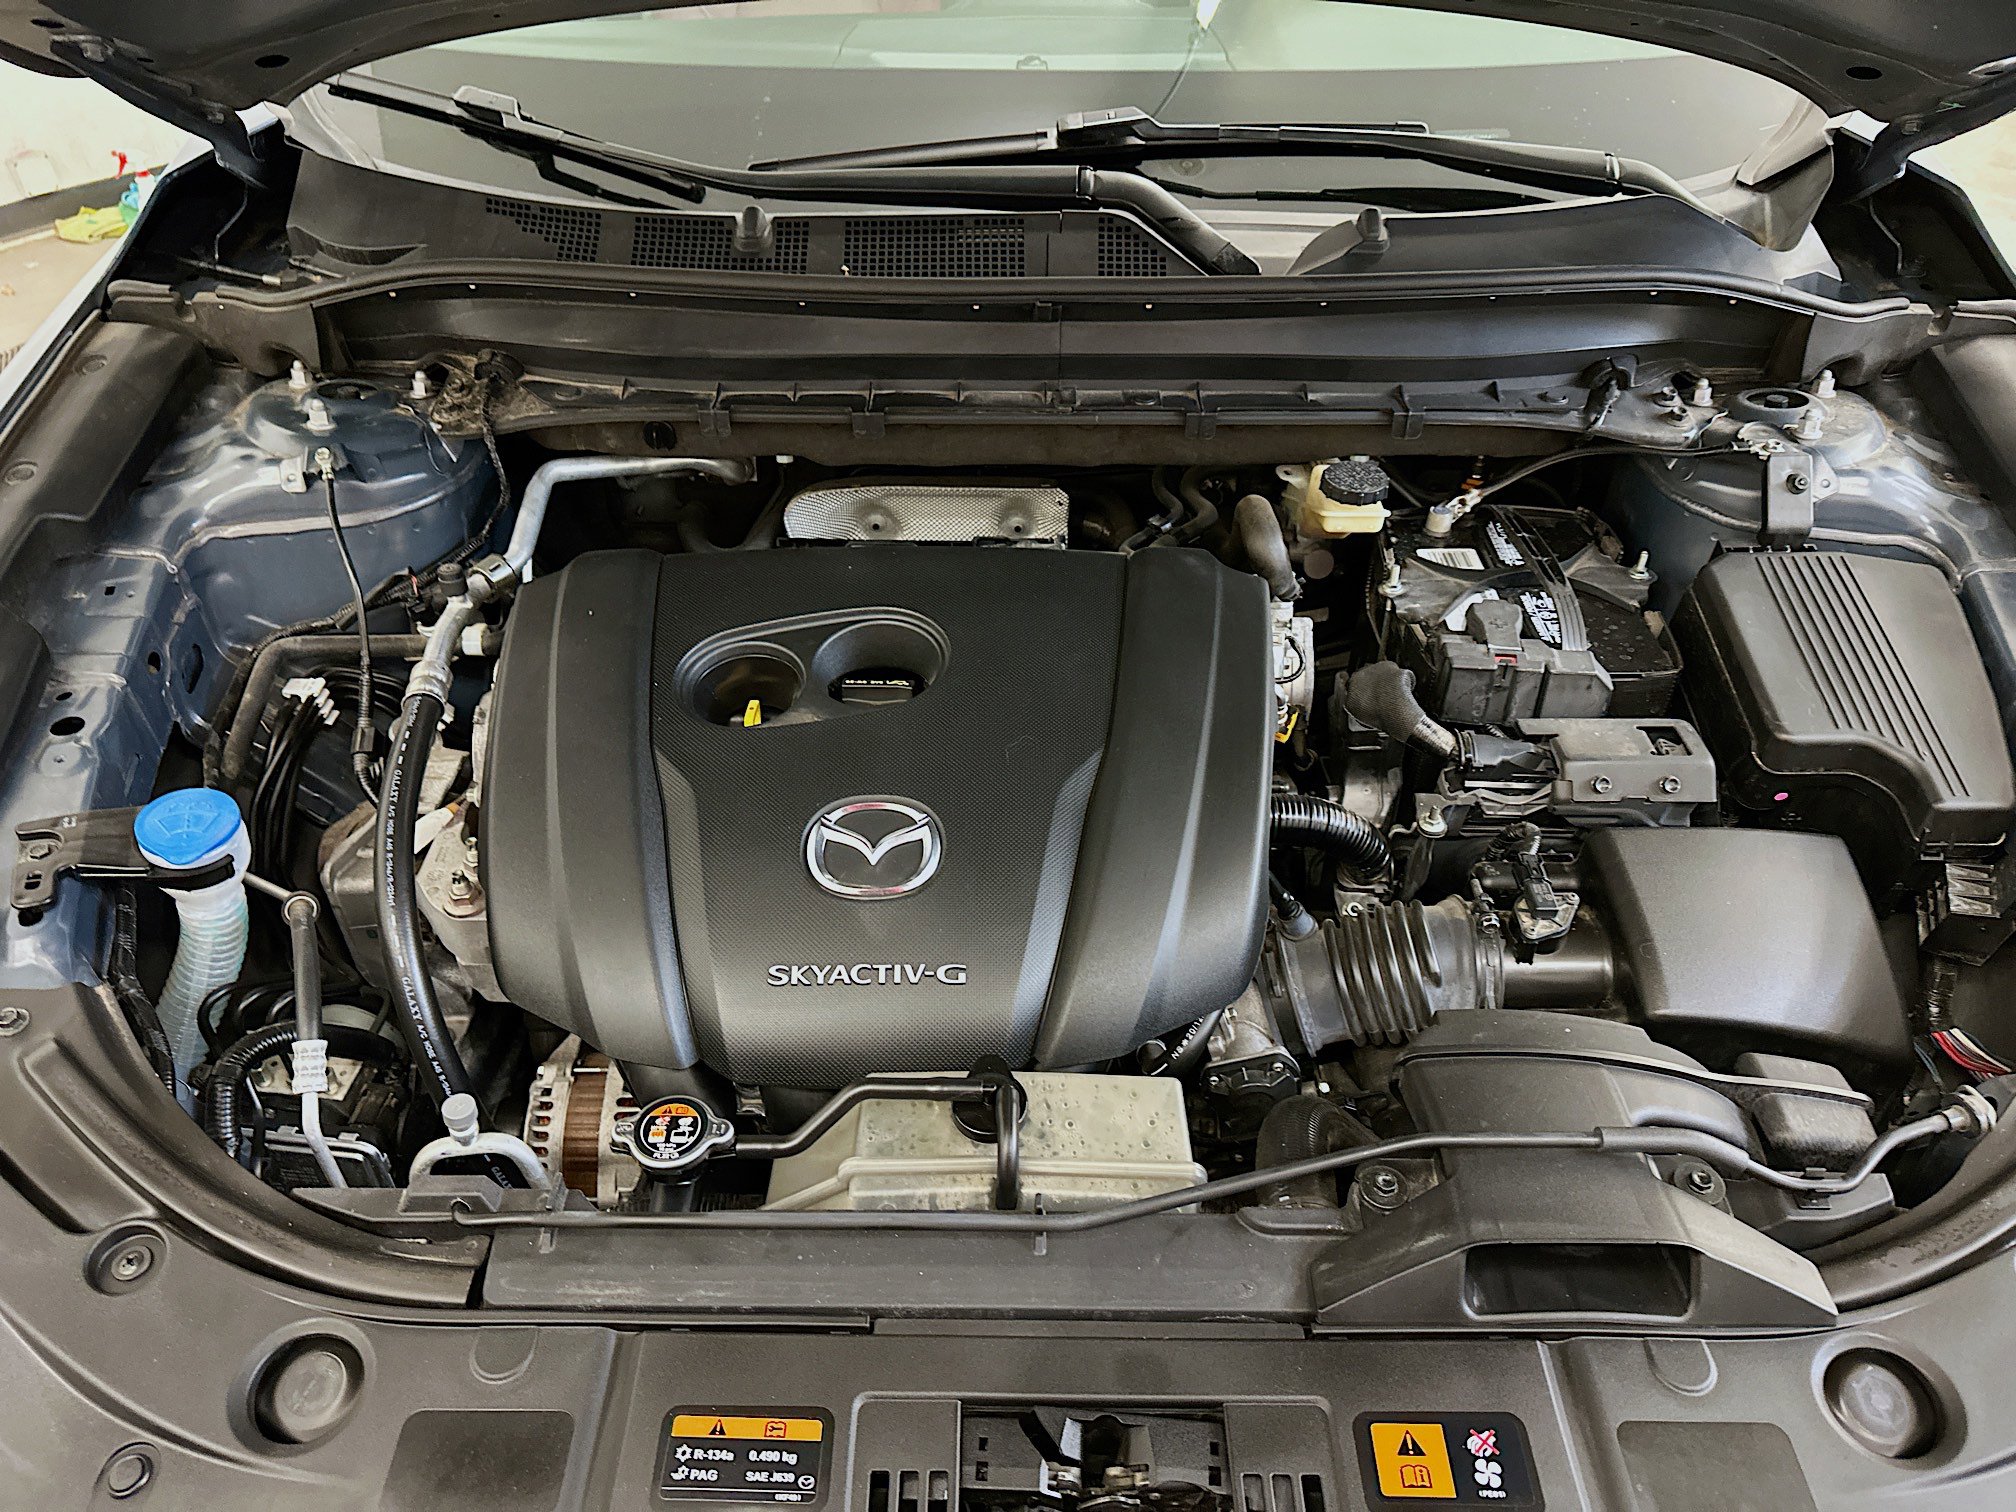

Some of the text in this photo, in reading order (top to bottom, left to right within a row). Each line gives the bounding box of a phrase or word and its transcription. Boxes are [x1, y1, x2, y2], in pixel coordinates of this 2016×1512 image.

[389, 769, 402, 803] GALAXY
[767, 963, 967, 986] SKYACTIV-G
[401, 976, 423, 1020] GALAXY
[693, 1449, 798, 1465] R-134a 0.490 kg
[690, 1470, 718, 1481] PAG
[745, 1471, 770, 1482] SAE
